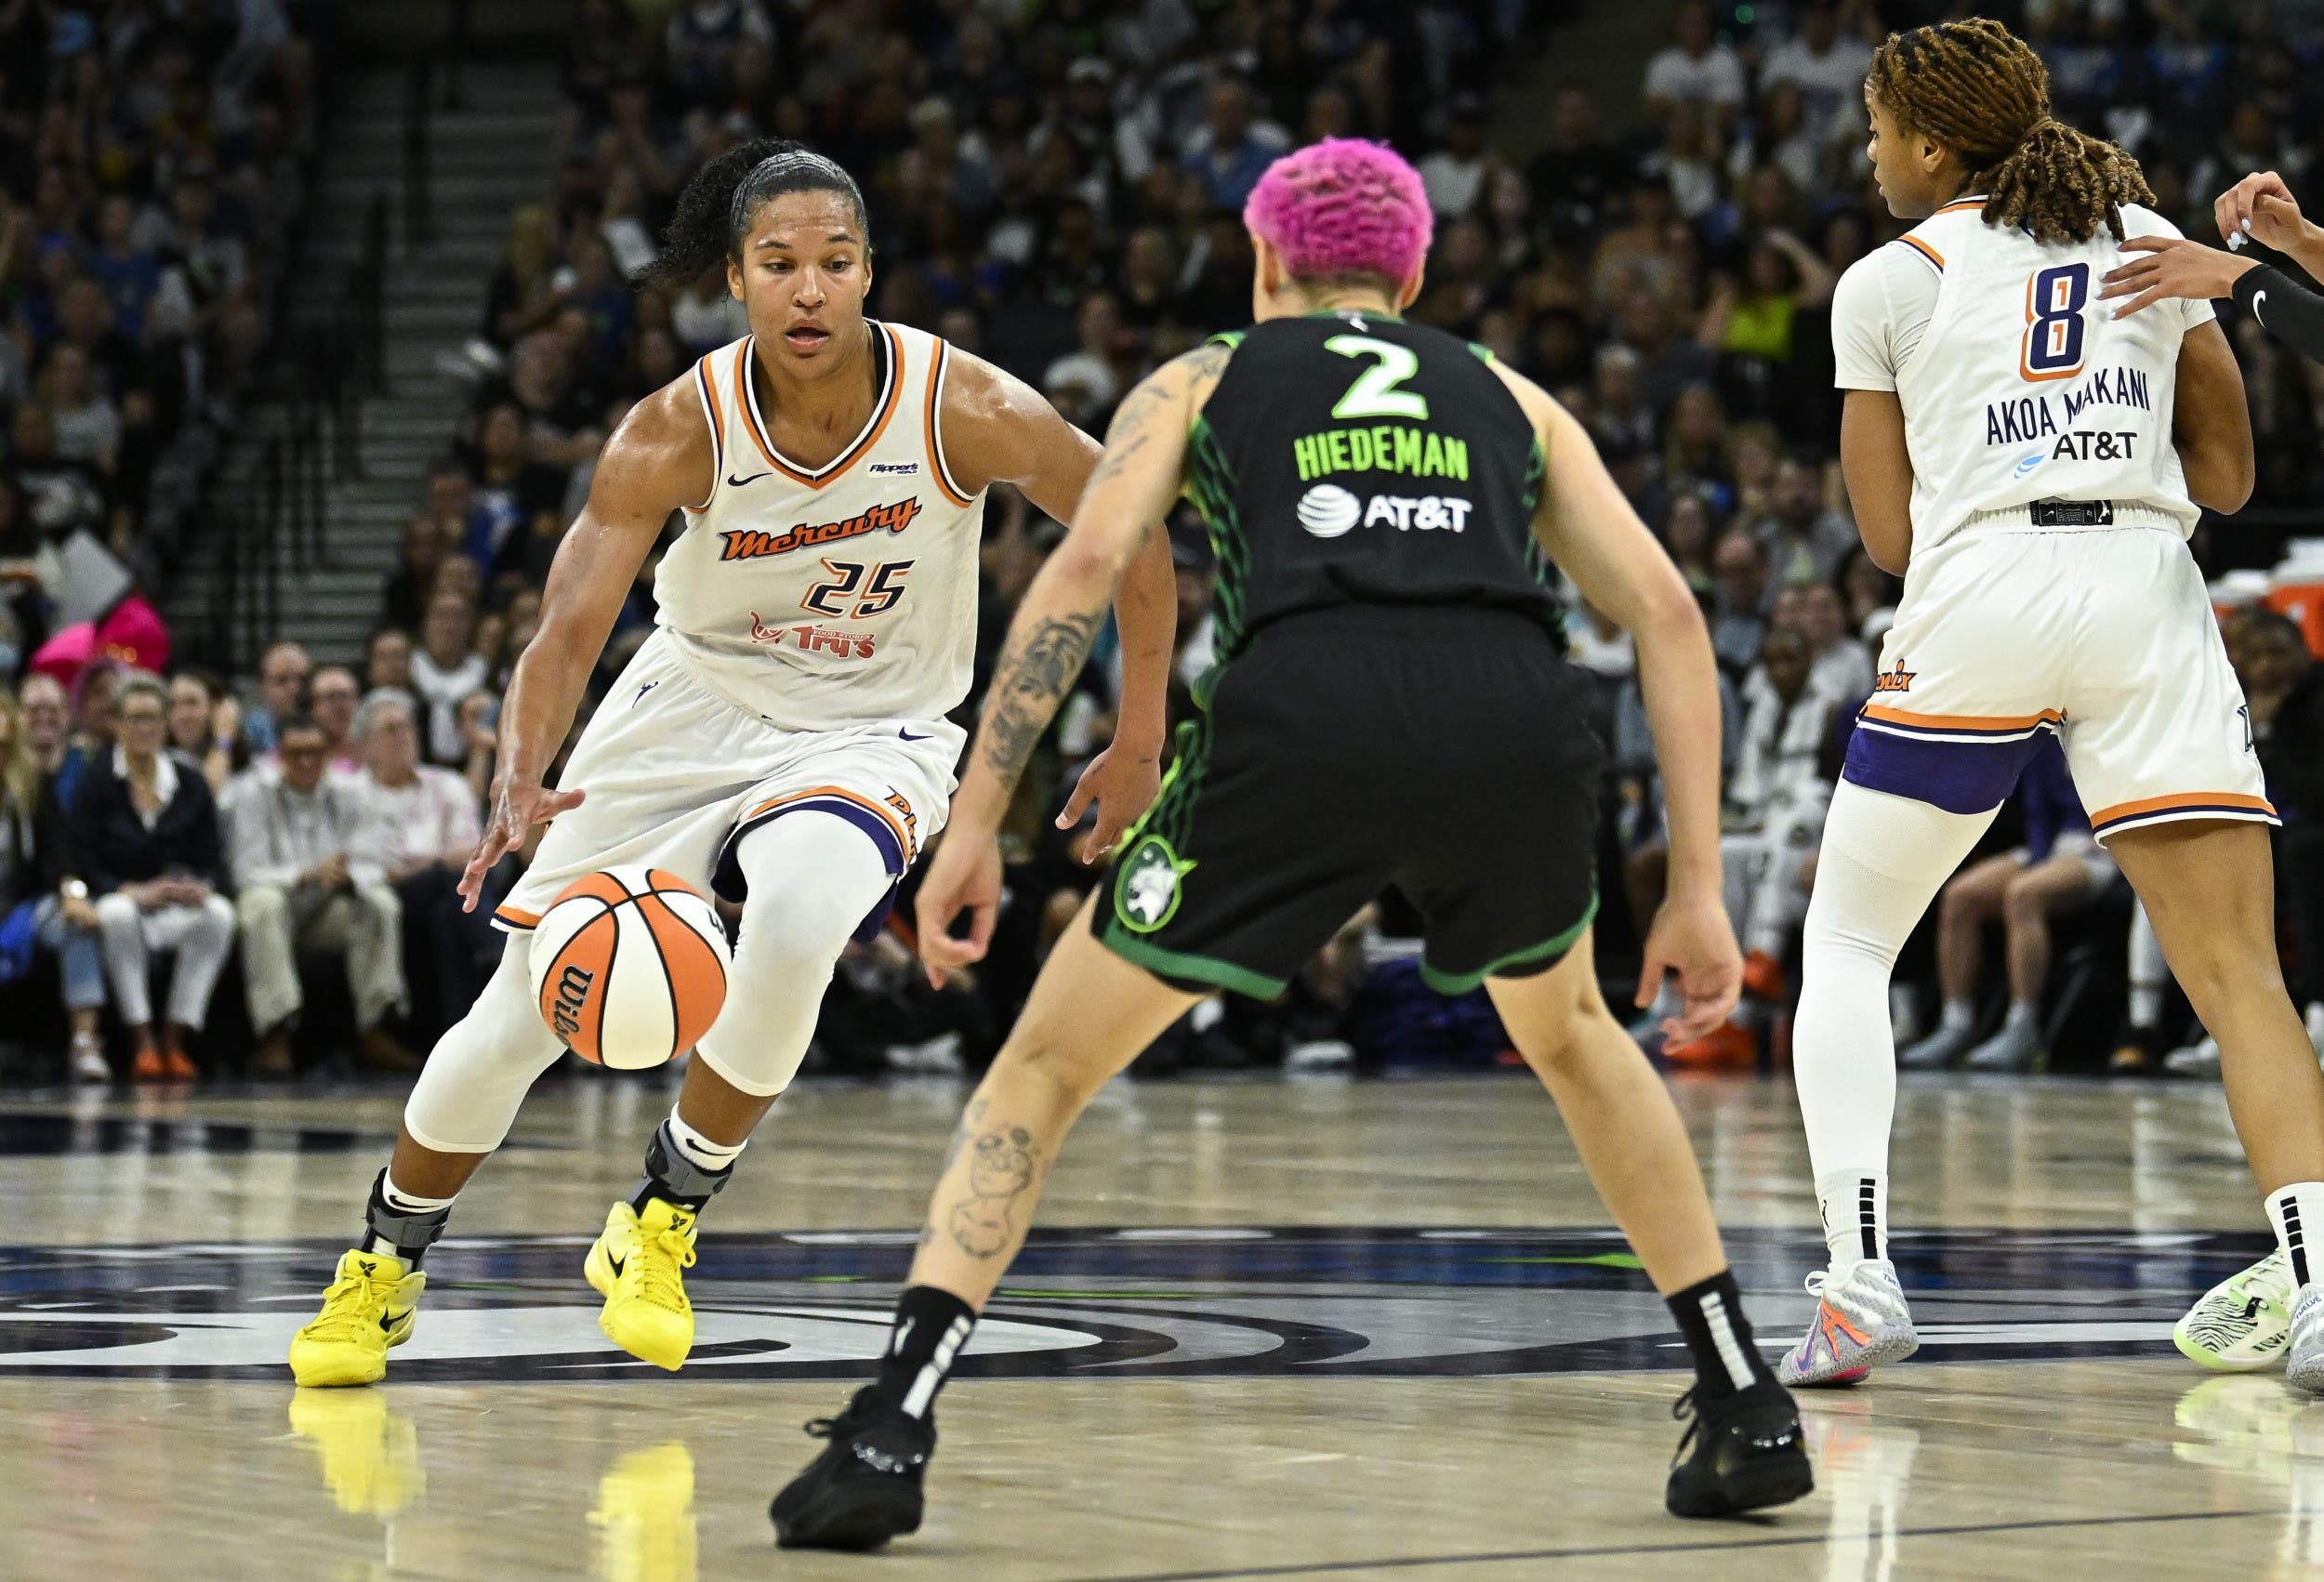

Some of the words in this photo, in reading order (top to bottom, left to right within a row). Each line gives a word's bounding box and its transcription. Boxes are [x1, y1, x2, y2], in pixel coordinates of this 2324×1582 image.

[2020, 262, 2090, 382] 8
[1324, 336, 1429, 420] 2
[1987, 396, 2058, 445] AKOA
[2063, 366, 2150, 426] MAKANI
[1294, 426, 1469, 481] HIEDEMAN
[2052, 430, 2137, 460] AT&T
[719, 495, 922, 560] Mercury
[1364, 494, 1472, 533] AT&T
[800, 557, 917, 619] 25
[1875, 659, 1917, 692] nix
